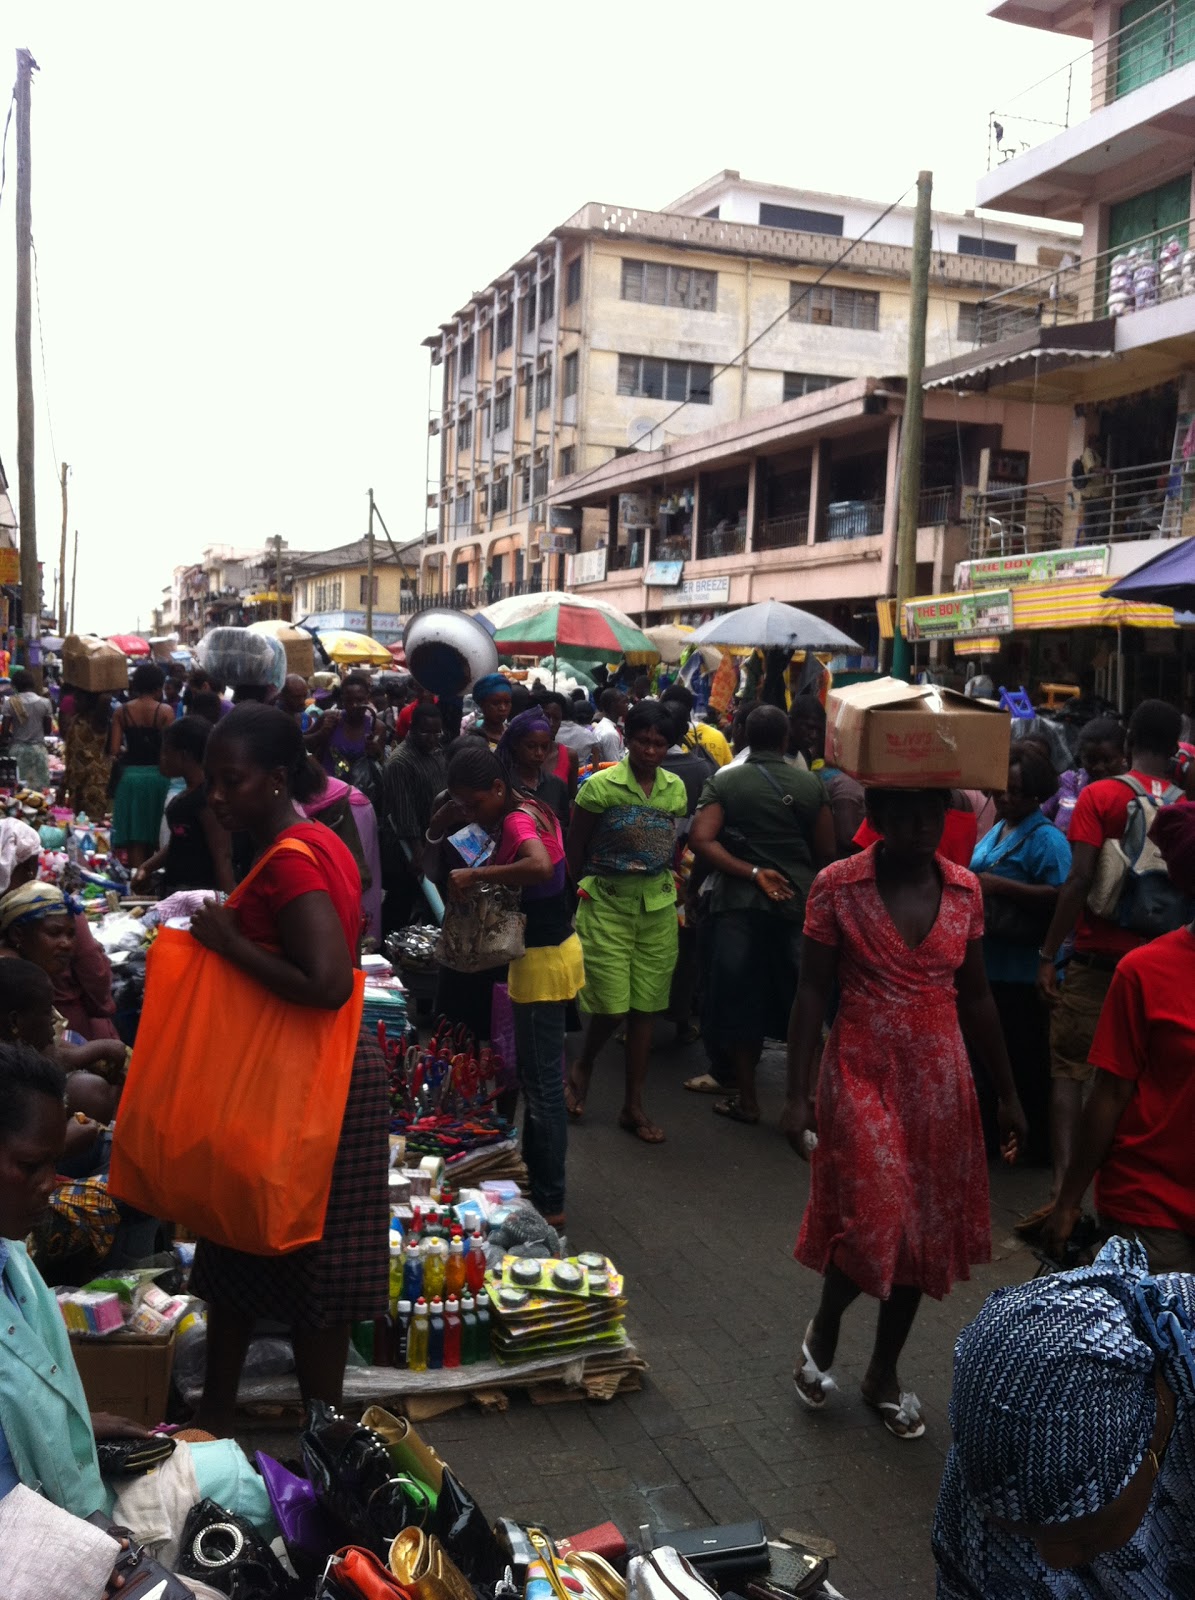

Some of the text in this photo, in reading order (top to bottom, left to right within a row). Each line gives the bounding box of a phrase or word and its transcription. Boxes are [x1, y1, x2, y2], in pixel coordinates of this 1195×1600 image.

[975, 559, 1034, 573] THE BOY
[695, 579, 728, 592] BREEZE
[917, 602, 961, 618] THE BOY
